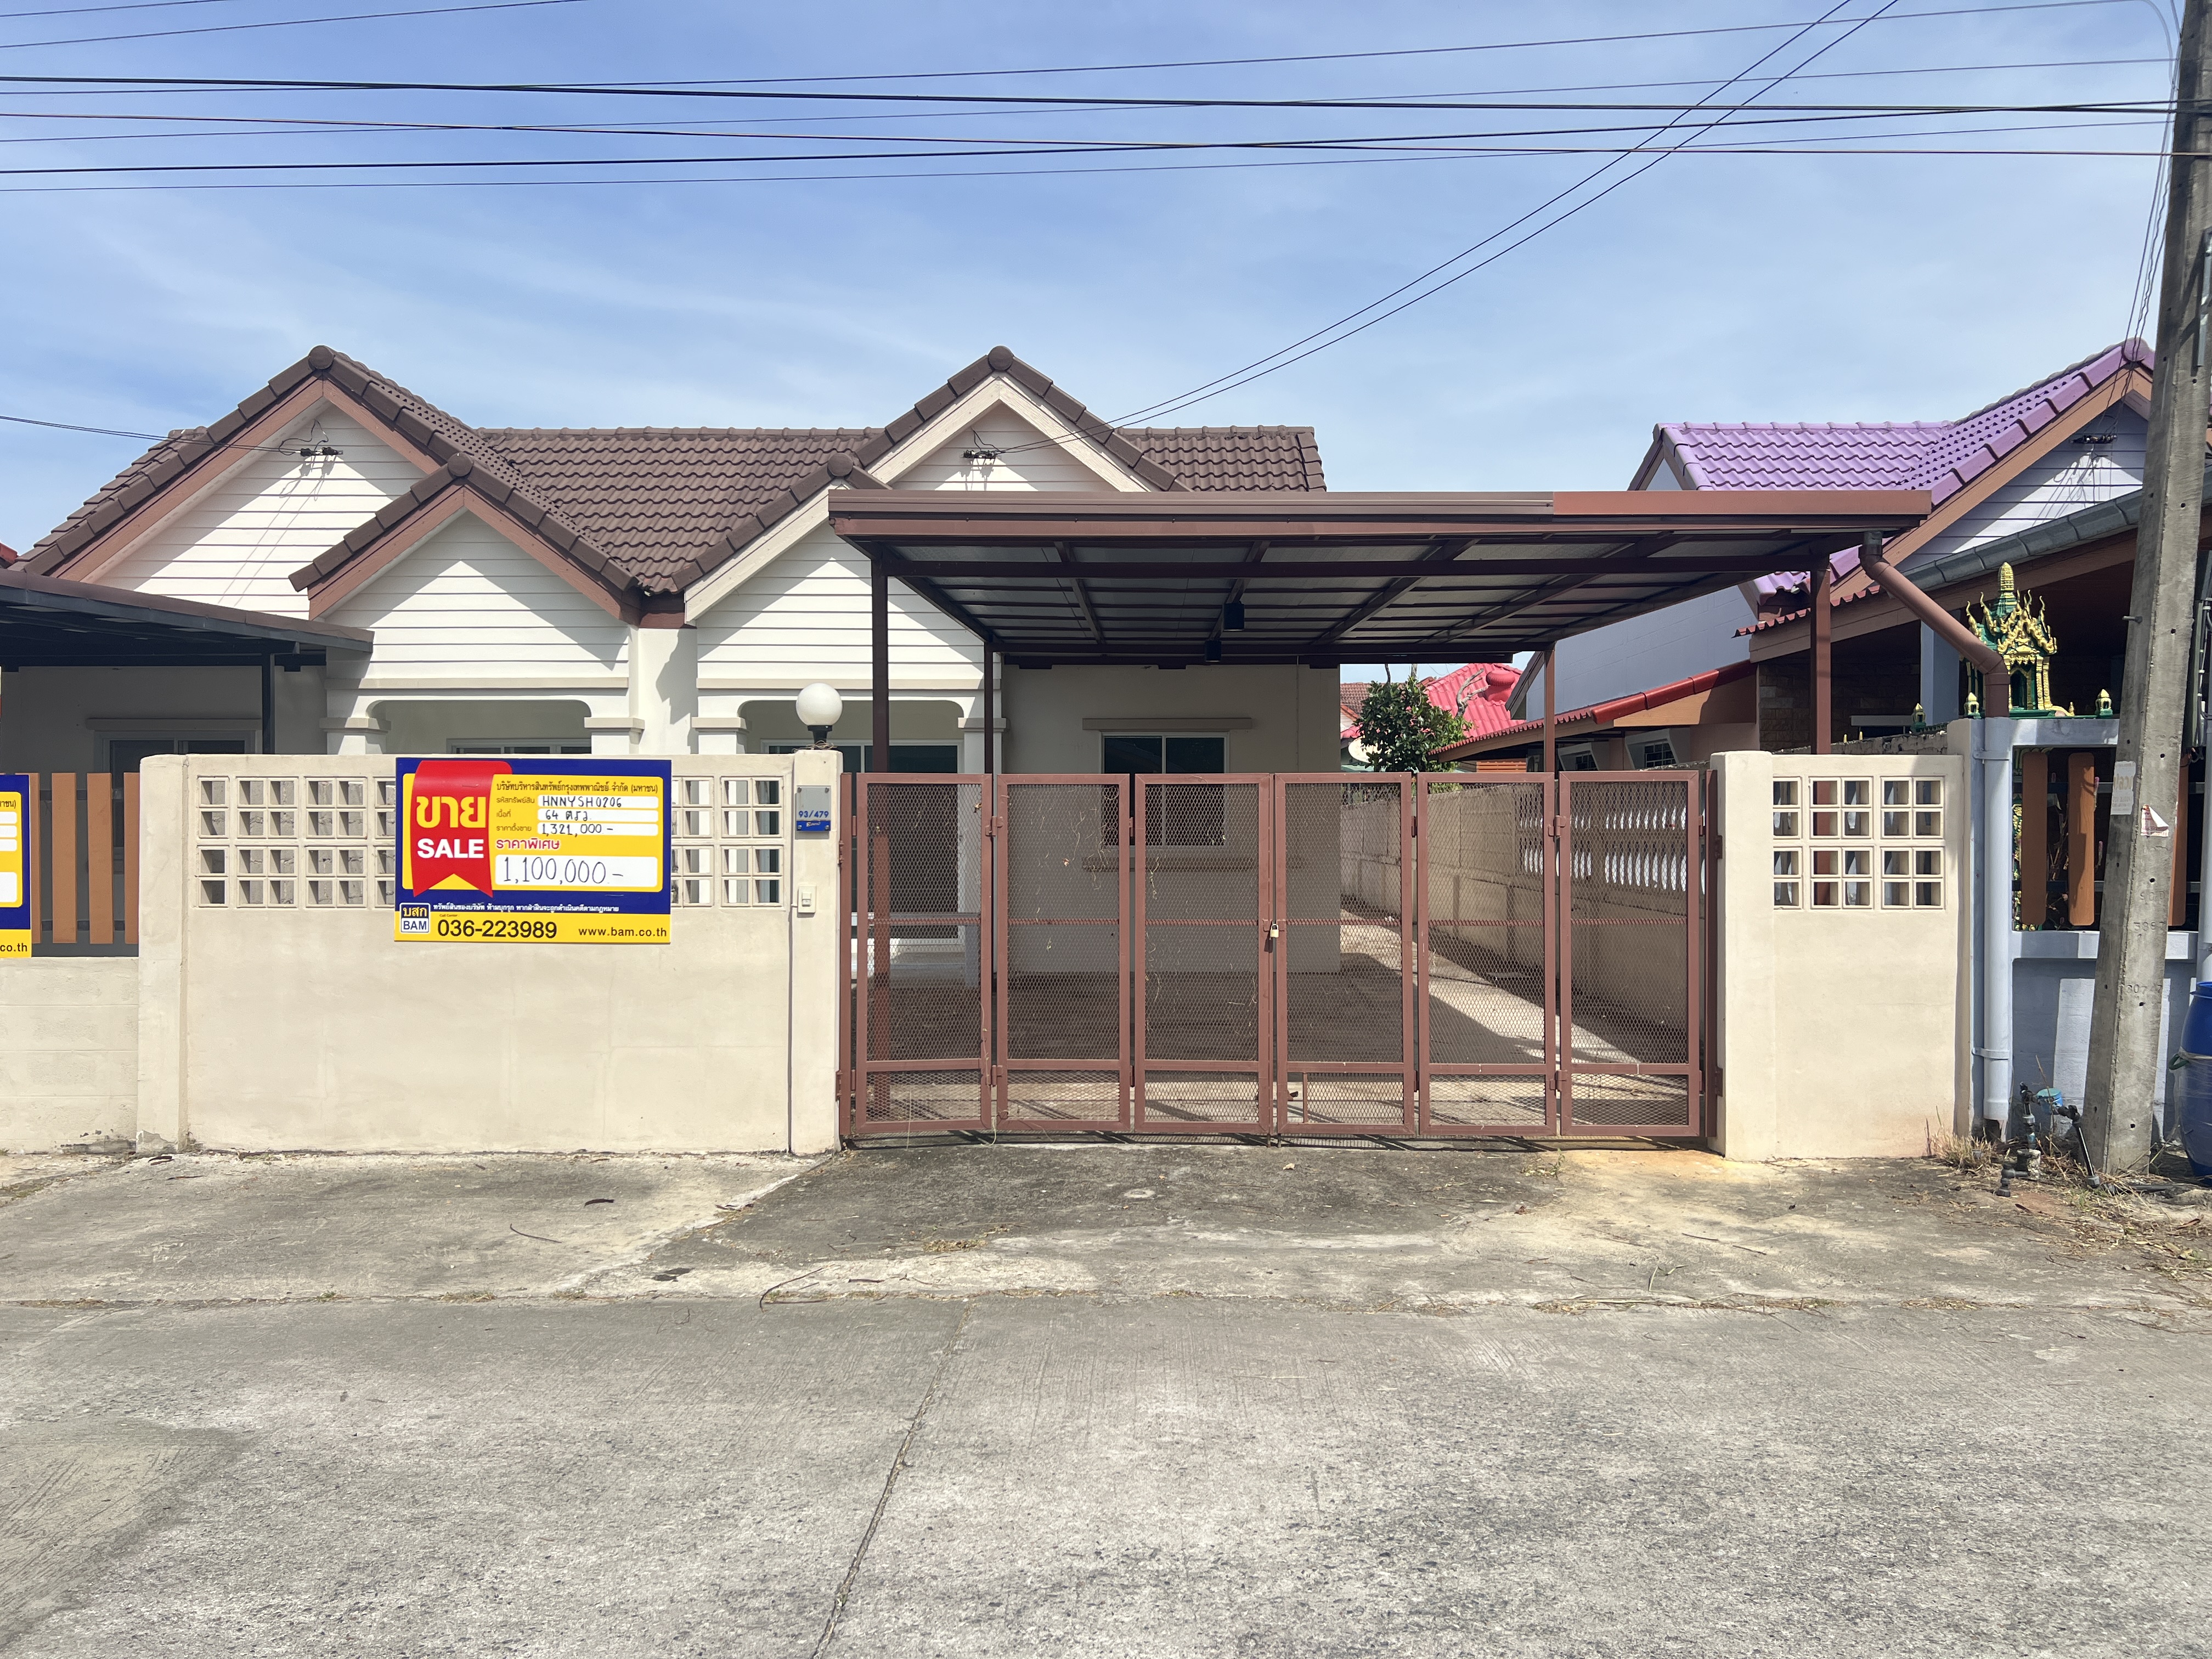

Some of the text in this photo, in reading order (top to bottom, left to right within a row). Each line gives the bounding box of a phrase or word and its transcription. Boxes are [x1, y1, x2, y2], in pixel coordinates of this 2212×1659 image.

[612, 782, 628, 791] จำกัด
[631, 785, 658, 793] (มหาชน)
[416, 796, 486, 828] ขาย
[546, 810, 558, 820] 64
[417, 838, 484, 859] SALE
[496, 838, 560, 850] ราคาพิเศษ
[403, 907, 427, 917] บสก
[403, 921, 426, 930] BAM
[437, 919, 557, 939] 036-223989
[579, 927, 667, 937] www.bam.co.th
